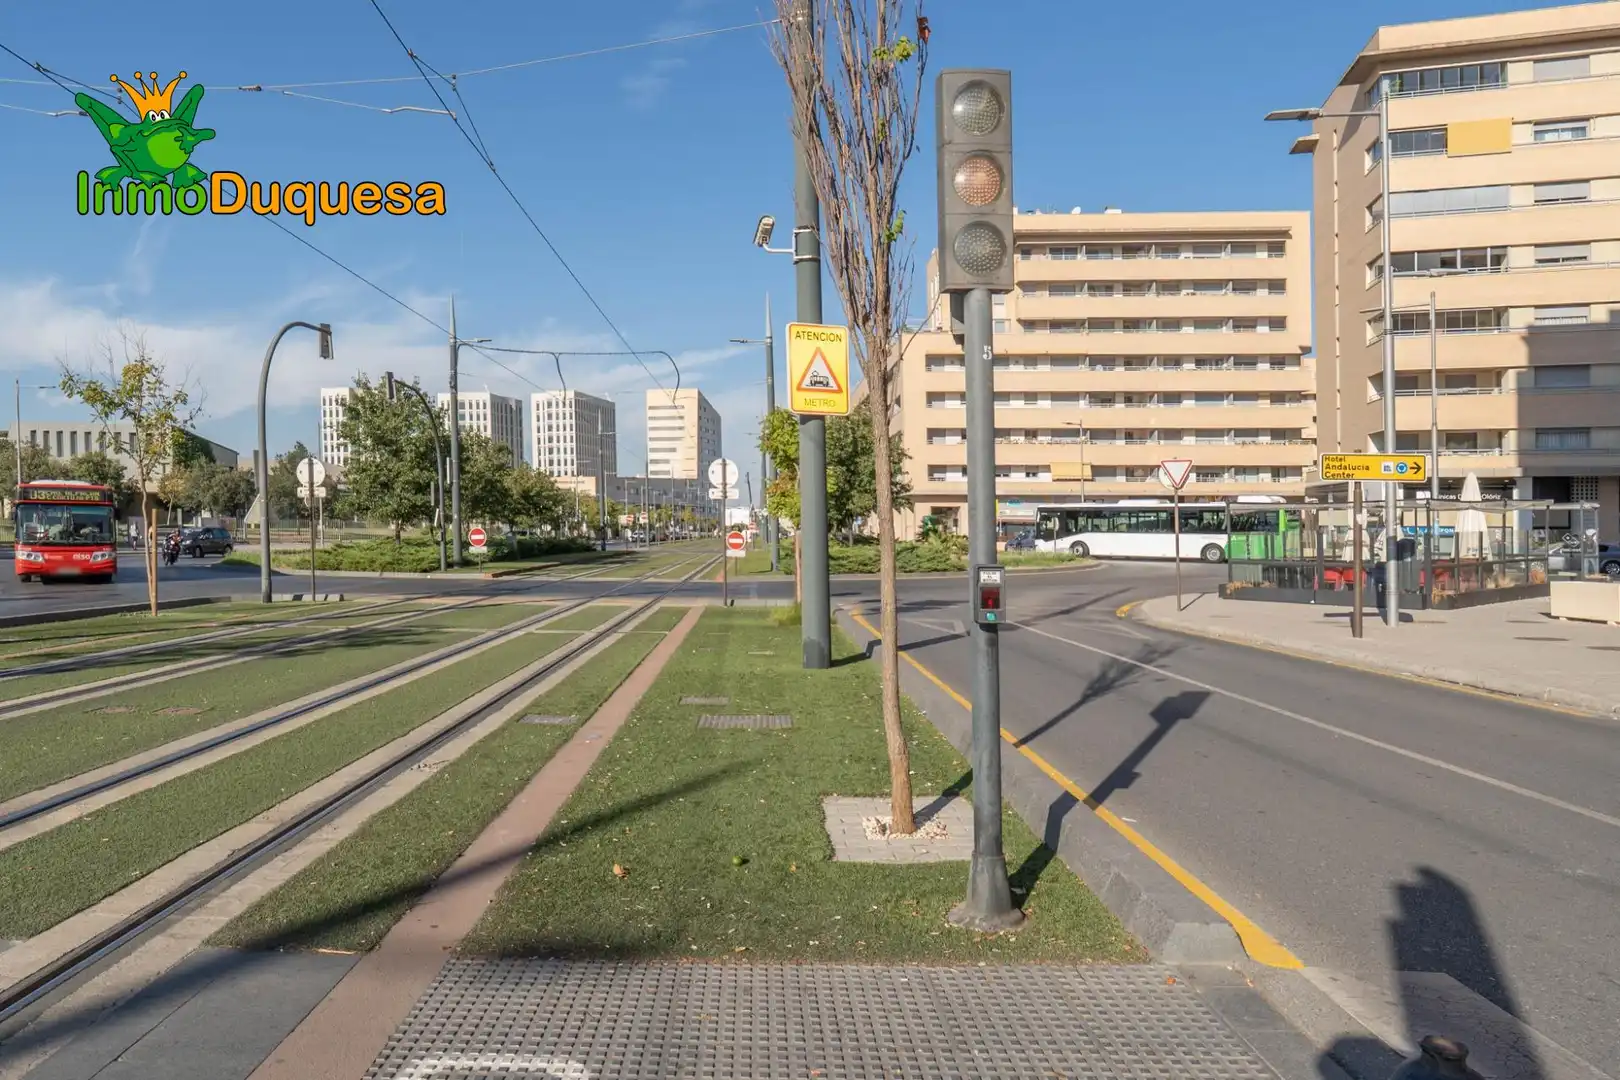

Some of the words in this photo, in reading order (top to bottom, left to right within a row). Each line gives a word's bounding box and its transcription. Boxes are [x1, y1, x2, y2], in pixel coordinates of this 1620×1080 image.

[795, 330, 843, 343] ATENCION
[804, 398, 836, 408] METRO
[1324, 455, 1346, 463] Hotel
[1324, 471, 1355, 479] Center
